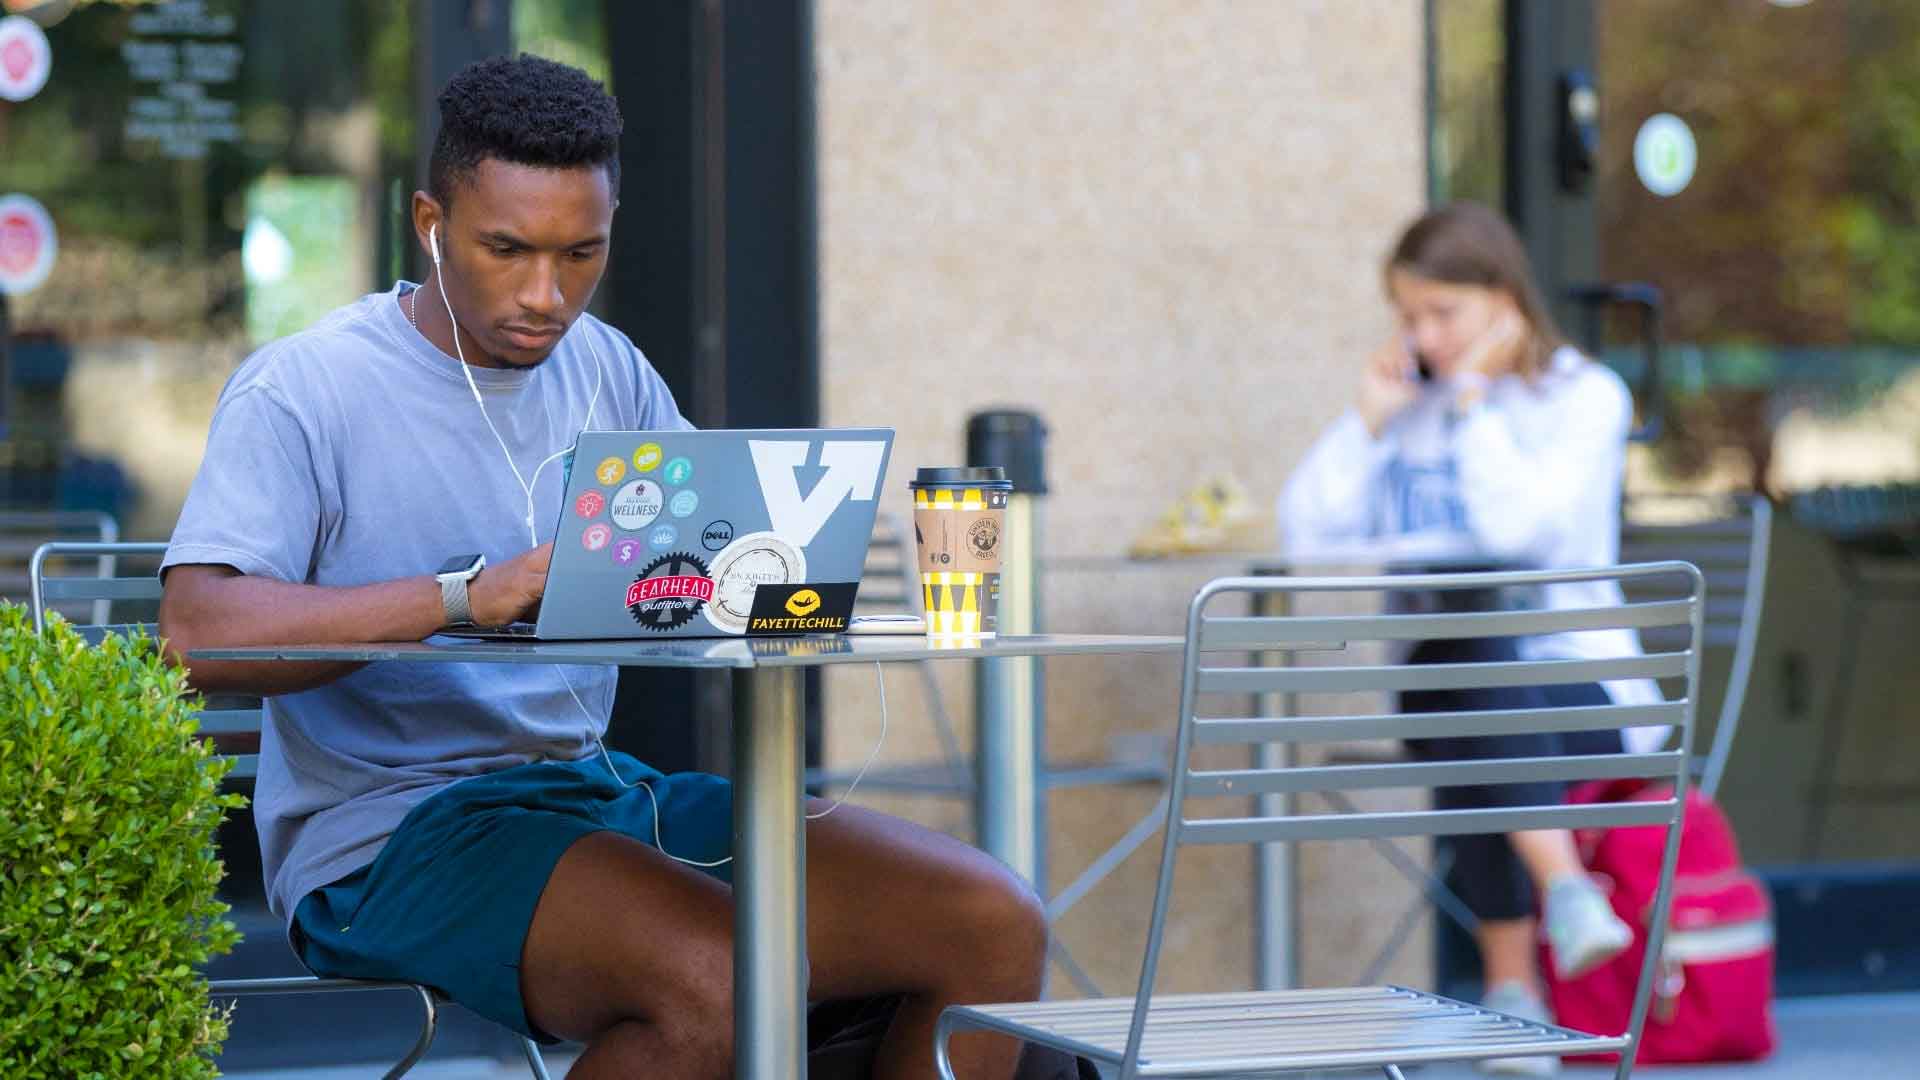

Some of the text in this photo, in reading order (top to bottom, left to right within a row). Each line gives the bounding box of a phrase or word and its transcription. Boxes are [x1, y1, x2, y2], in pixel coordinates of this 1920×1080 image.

[613, 504, 659, 516] WELLNESS
[705, 532, 729, 540] DELL
[629, 578, 710, 602] GEARHEAD
[642, 600, 694, 611] outfitters
[752, 617, 844, 629] FAYETTECHILL
